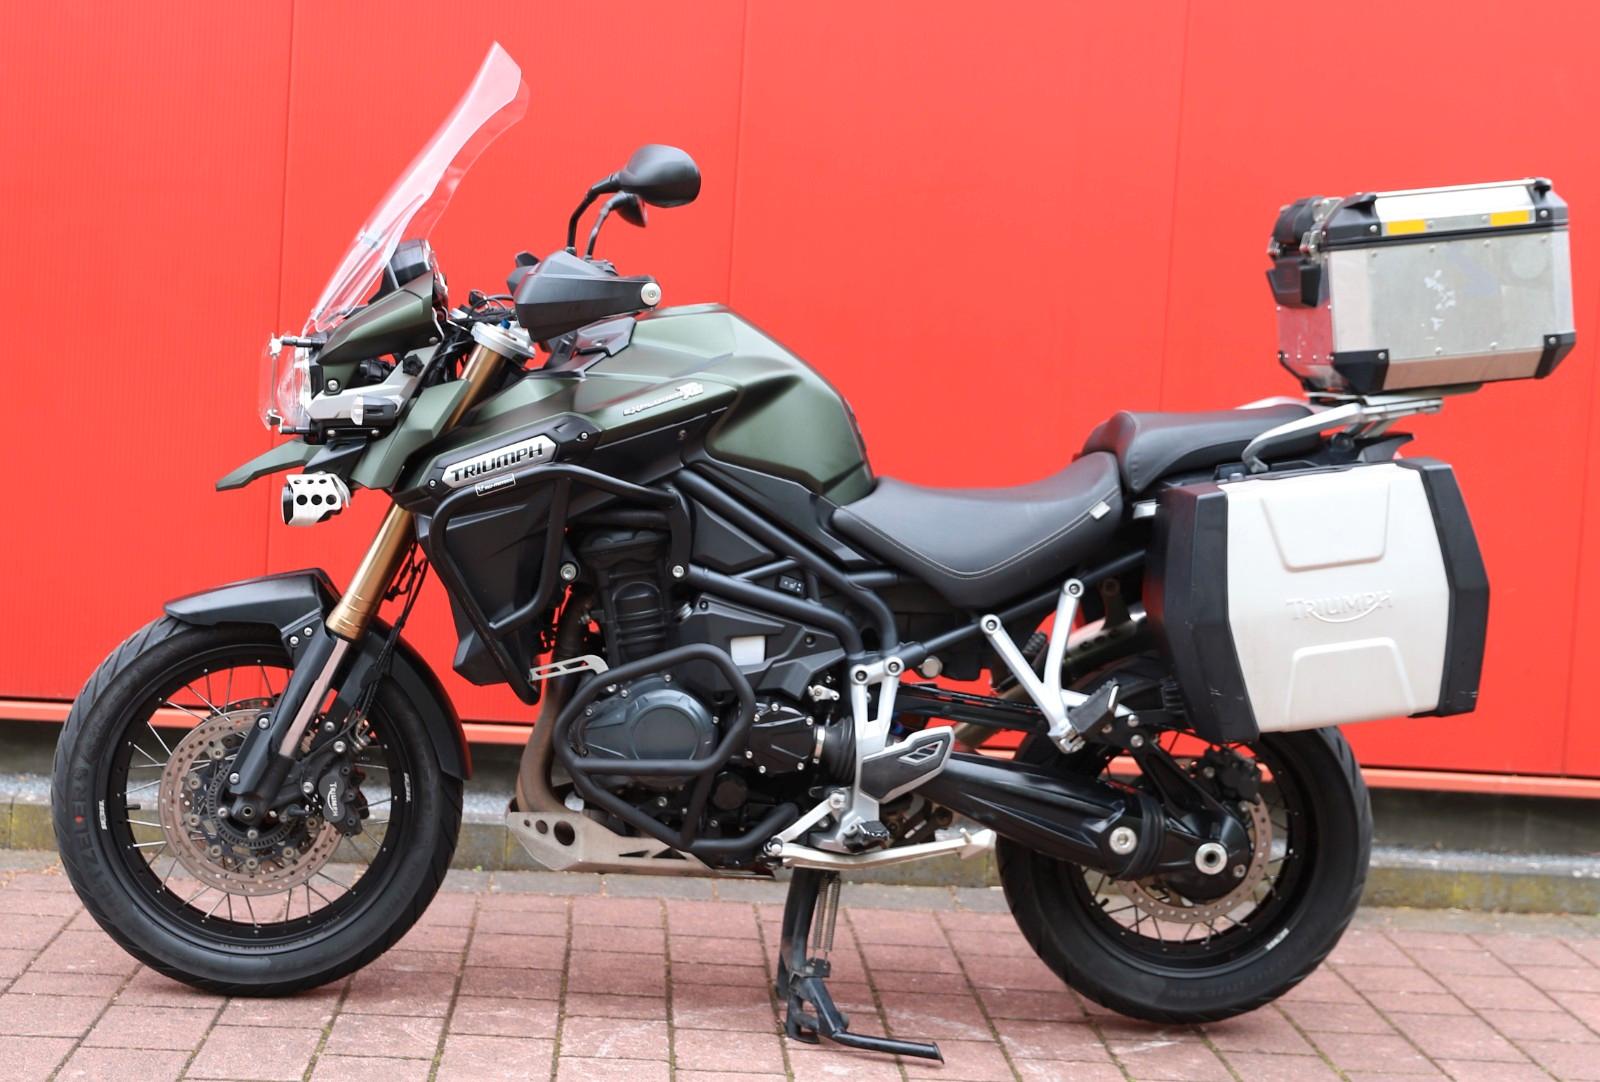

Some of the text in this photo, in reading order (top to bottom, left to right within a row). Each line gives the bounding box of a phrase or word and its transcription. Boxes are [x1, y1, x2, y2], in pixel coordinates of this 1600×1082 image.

[450, 443, 543, 481] TRIUMPH
[1285, 590, 1393, 621] TRIUMPH
[327, 781, 339, 817] TRIUMPH
